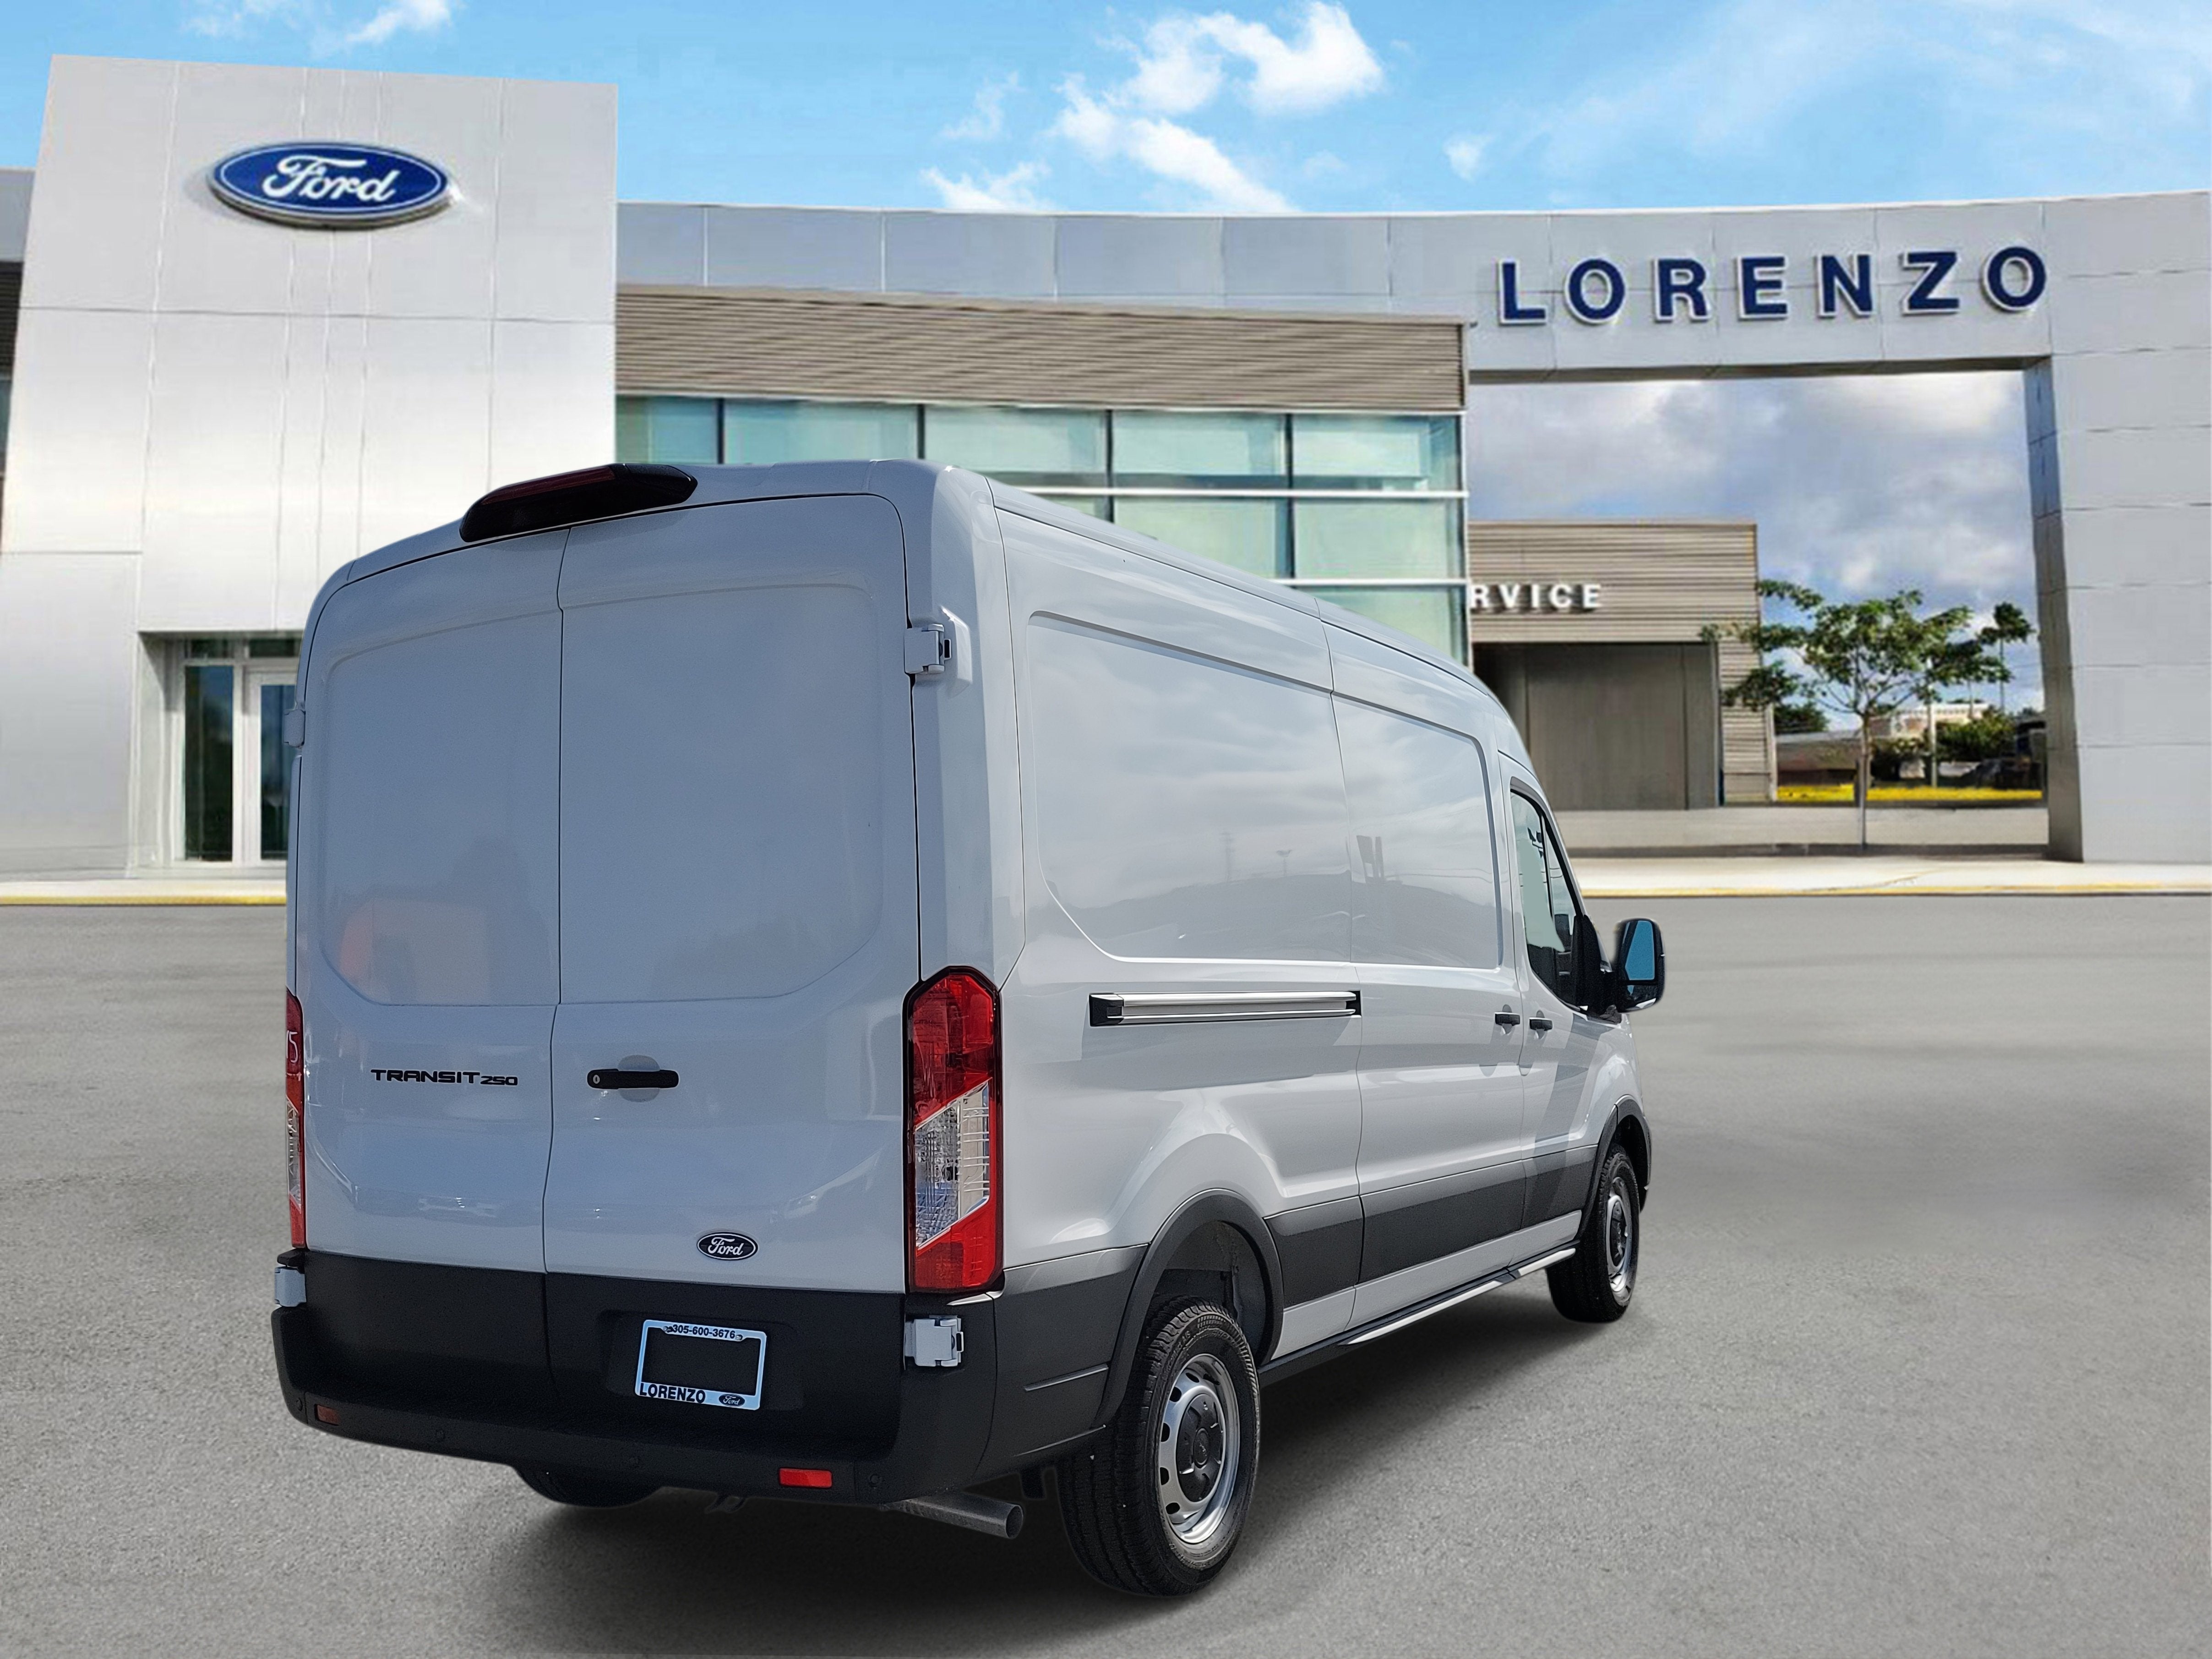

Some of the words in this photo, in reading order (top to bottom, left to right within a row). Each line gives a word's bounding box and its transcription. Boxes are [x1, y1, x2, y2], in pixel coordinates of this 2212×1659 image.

[262, 154, 400, 201] Ford
[1499, 246, 2047, 323] LORENZO
[370, 1069, 480, 1084] TRANSIT
[480, 1075, 518, 1086] 250
[708, 1237, 744, 1255] Ford
[672, 1324, 736, 1339] 305-600-3676
[639, 1382, 706, 1404] LORENZO
[723, 1395, 741, 1406] Ford
